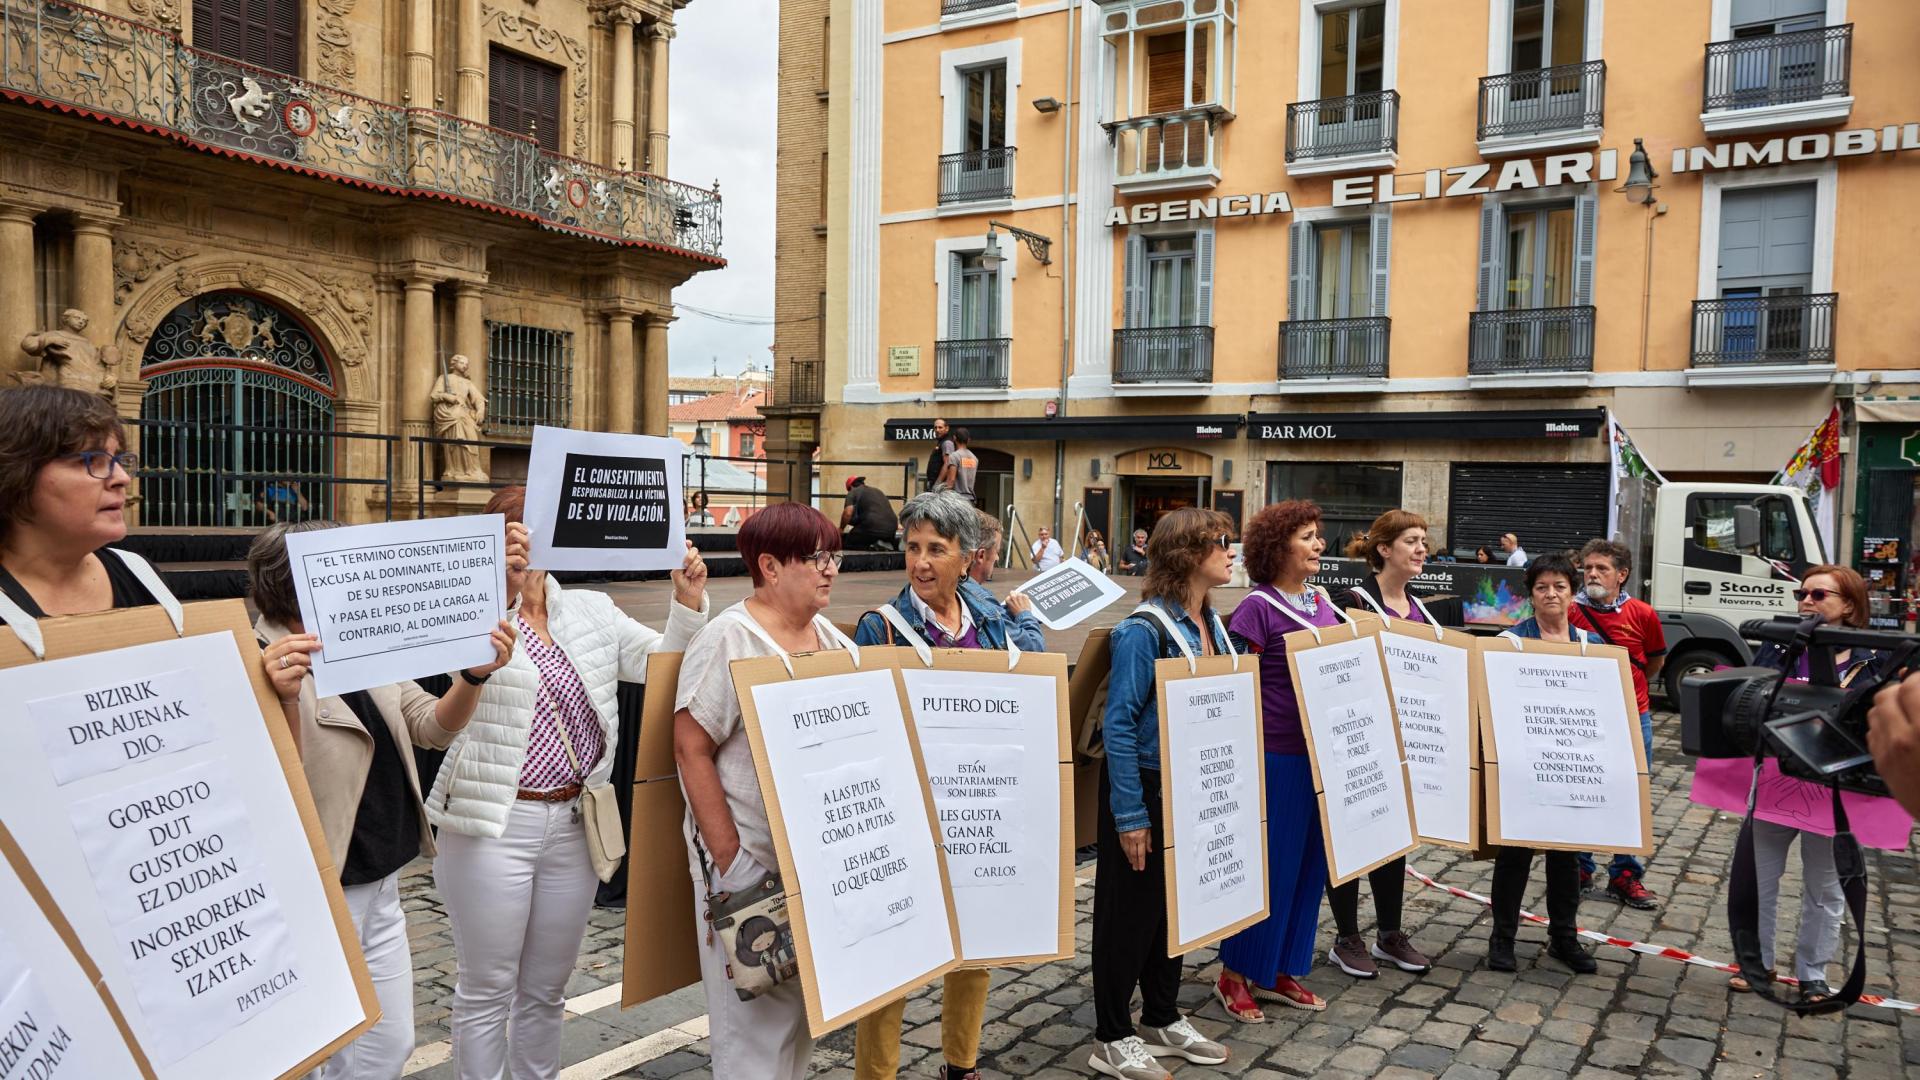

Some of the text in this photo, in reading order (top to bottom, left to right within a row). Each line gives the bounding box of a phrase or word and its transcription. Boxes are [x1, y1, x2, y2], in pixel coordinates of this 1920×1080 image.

[1103, 191, 1294, 228] AGENCIA
[1332, 149, 1617, 208] ELIZARI
[896, 429, 920, 440] BAR
[1261, 425, 1337, 439] BAR MOL
[1545, 422, 1580, 431] Mahou
[1723, 441, 1736, 457] 2
[1149, 453, 1180, 467] MOL
[574, 467, 665, 486] EL CONSENTIMIENTO
[572, 486, 628, 499] RESPONSABILIZA
[629, 489, 634, 500] A
[635, 489, 643, 500] LA
[567, 502, 666, 522] DE SU VIOLACIÓN.
[340, 549, 396, 565] TERMINO
[398, 540, 486, 558] CONSENTIMIENTO
[311, 556, 494, 588] EXCUSA AL DOMINANTE, LO LIBERA
[1409, 572, 1453, 582] tands
[347, 576, 472, 602] DE SU RESPONSABILIDAD
[1720, 581, 1785, 594] Stands
[329, 592, 490, 624] Y PASA EL PESO DE LA CARGA AL
[1719, 597, 1765, 607] Navarro,
[339, 622, 404, 642] CONTRARIO,
[406, 621, 419, 631] AL
[1384, 646, 1438, 665] PUTAZALEAK
[1319, 657, 1361, 675] SUPERVIVIENTE
[1519, 667, 1589, 680] SUPERVIVIENTE
[84, 680, 159, 713] BIZIRIK
[922, 697, 1020, 714] PUTERO DICE:
[1189, 690, 1235, 707] SUPERVIVIENTE
[1410, 697, 1426, 707] DUT
[792, 701, 871, 729] PUTERO DICE:
[1347, 708, 1356, 718] LA
[1410, 710, 1441, 721] IZATEKO
[1523, 704, 1596, 717] SI PUDIÉRAMOS
[68, 700, 190, 746] DIRAUENAK
[1559, 717, 1598, 728] SIEMPRE
[1347, 731, 1366, 745] EXISTE
[1527, 725, 1598, 739] DIRÍAMOS QUE
[122, 735, 165, 760] DIO:
[1200, 745, 1234, 761] ESTOY POR
[1347, 742, 1370, 758] PORQUE
[1542, 751, 1595, 762] NOSOTRAS
[958, 760, 986, 774] ESTÁN
[1346, 760, 1379, 779] EXISTEN LOS
[1201, 773, 1235, 791] NO TENGO
[1536, 773, 1605, 785] ELLOS DESEAN.
[823, 778, 881, 805] A LAS PUTAS
[947, 788, 997, 798] SON LIBRES.
[1210, 790, 1229, 803] OTRA
[1570, 793, 1599, 802] SARAH
[107, 781, 211, 830] GORROTO
[825, 797, 886, 824] SE LES TRATA
[940, 809, 1002, 821] LES GUSTA
[148, 815, 193, 847] DUT
[822, 823, 855, 845] COMO
[857, 821, 865, 835] A
[947, 825, 995, 838] GANAR
[1214, 822, 1227, 835] LOS
[943, 843, 977, 855] NERO
[1207, 834, 1235, 852] CLIENTES
[128, 834, 224, 885] GUSTOKO
[843, 844, 890, 872] LES HACES
[1208, 849, 1233, 867] ME DAN
[832, 857, 909, 897] LO QUE QUIERES.
[974, 866, 1017, 878] CARLOS
[1199, 870, 1216, 886] ASCO
[1217, 867, 1222, 878] Y
[137, 857, 238, 913] EZ DUDAN
[887, 895, 914, 917] SERGIO
[129, 883, 266, 960] INORROREKIN
[170, 921, 251, 973] SEXURIK
[186, 952, 257, 998] IZATEA.
[236, 968, 299, 1013] PATRICIA
